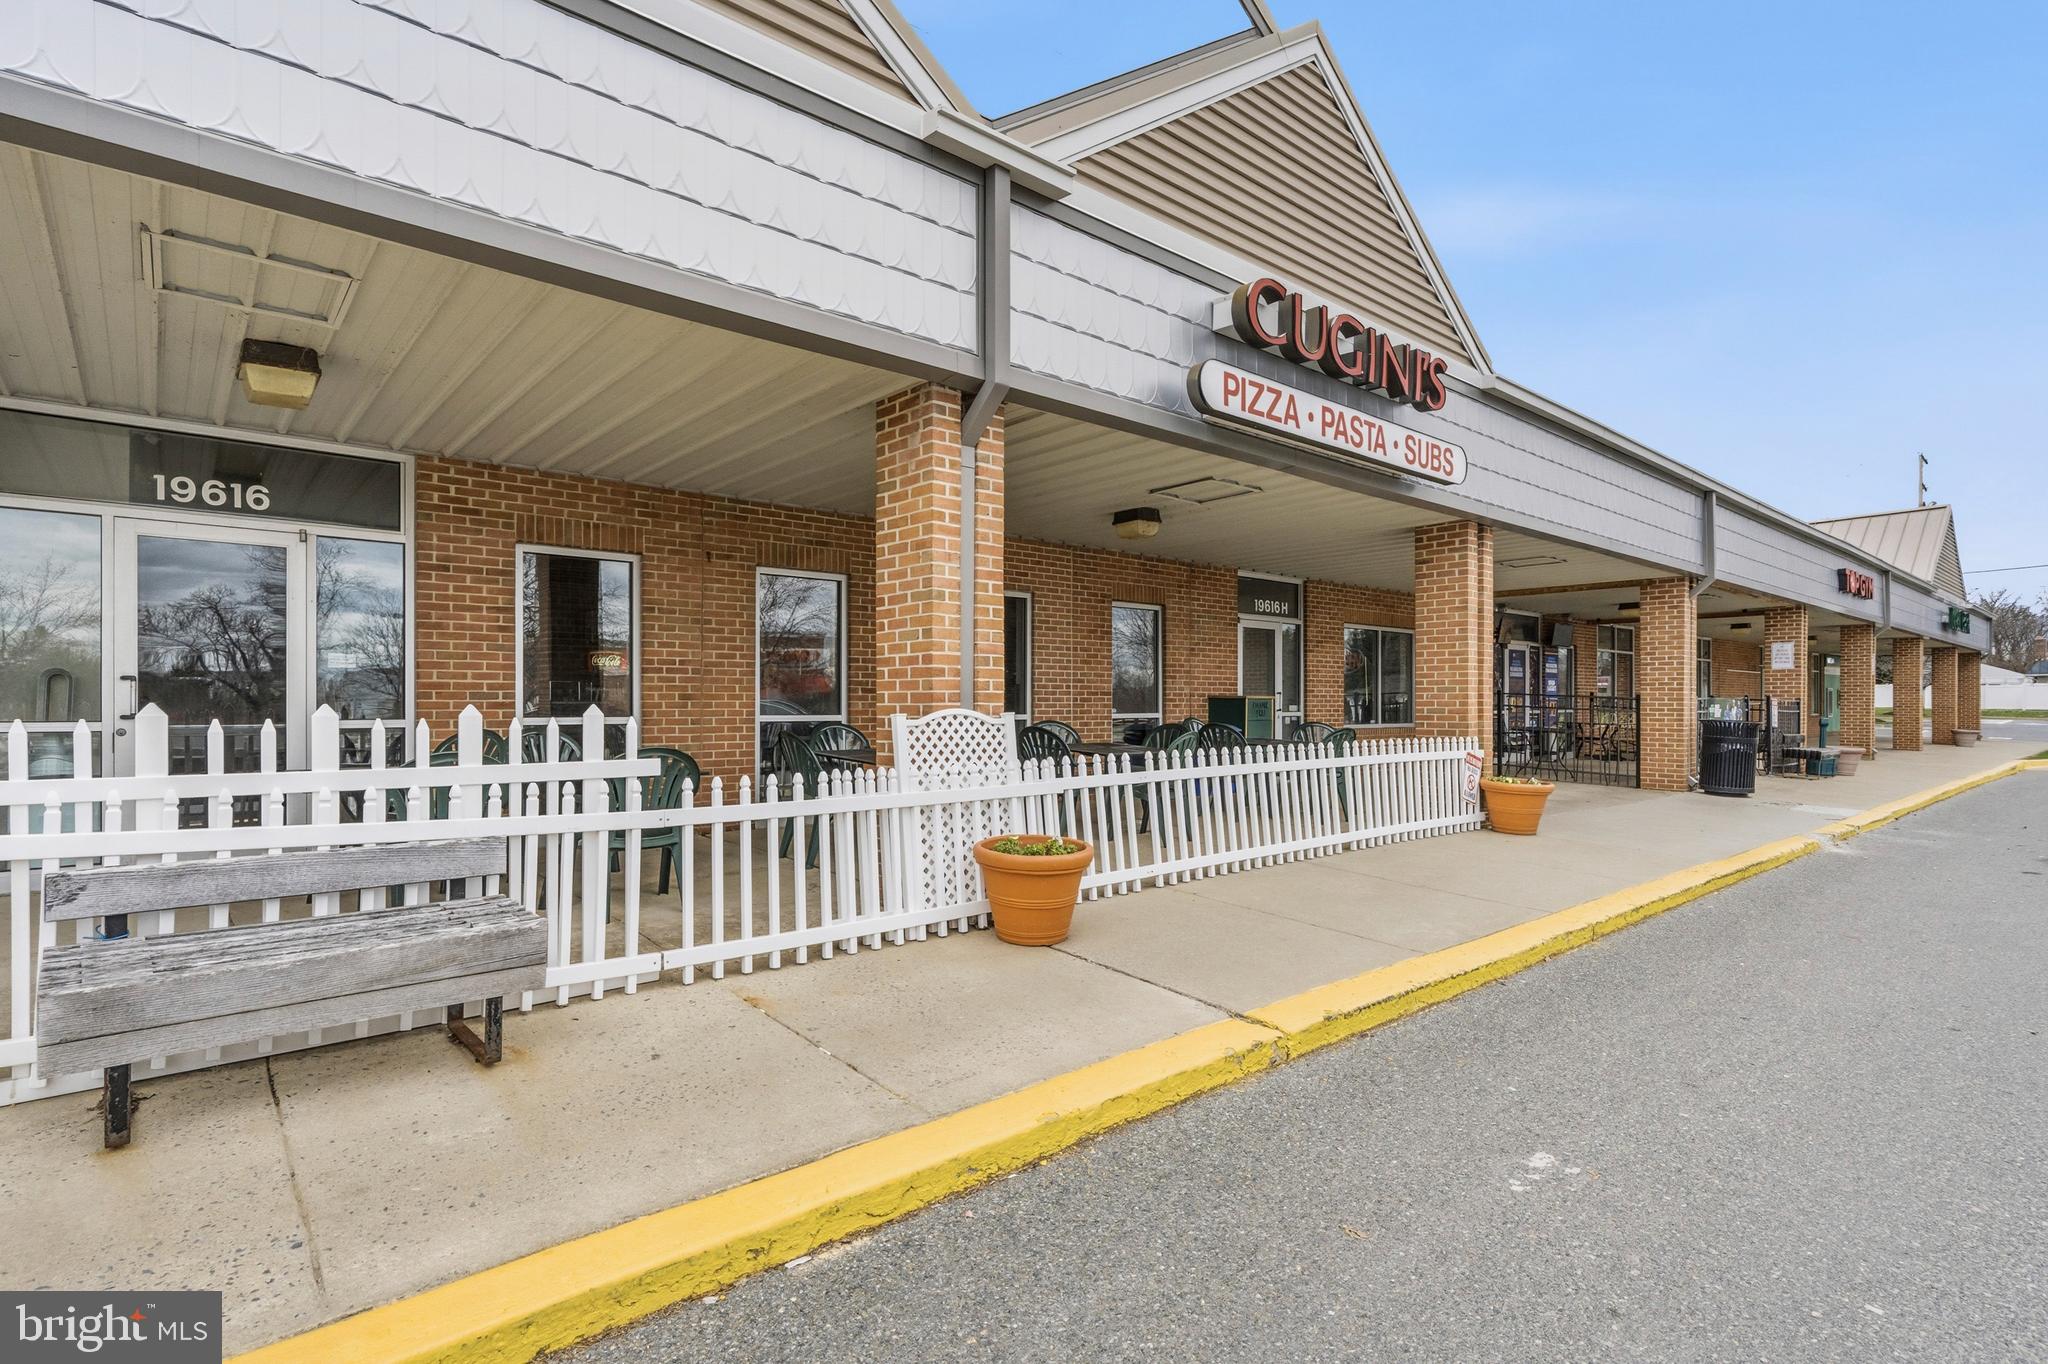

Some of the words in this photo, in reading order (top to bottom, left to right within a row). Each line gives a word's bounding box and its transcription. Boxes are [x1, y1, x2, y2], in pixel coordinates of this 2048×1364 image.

[1247, 278, 1448, 412] CUGINI'S
[1223, 371, 1301, 429] PIZZA
[1321, 405, 1388, 456] PASTA
[1404, 434, 1454, 477] SUBS
[153, 474, 271, 511] 19616
